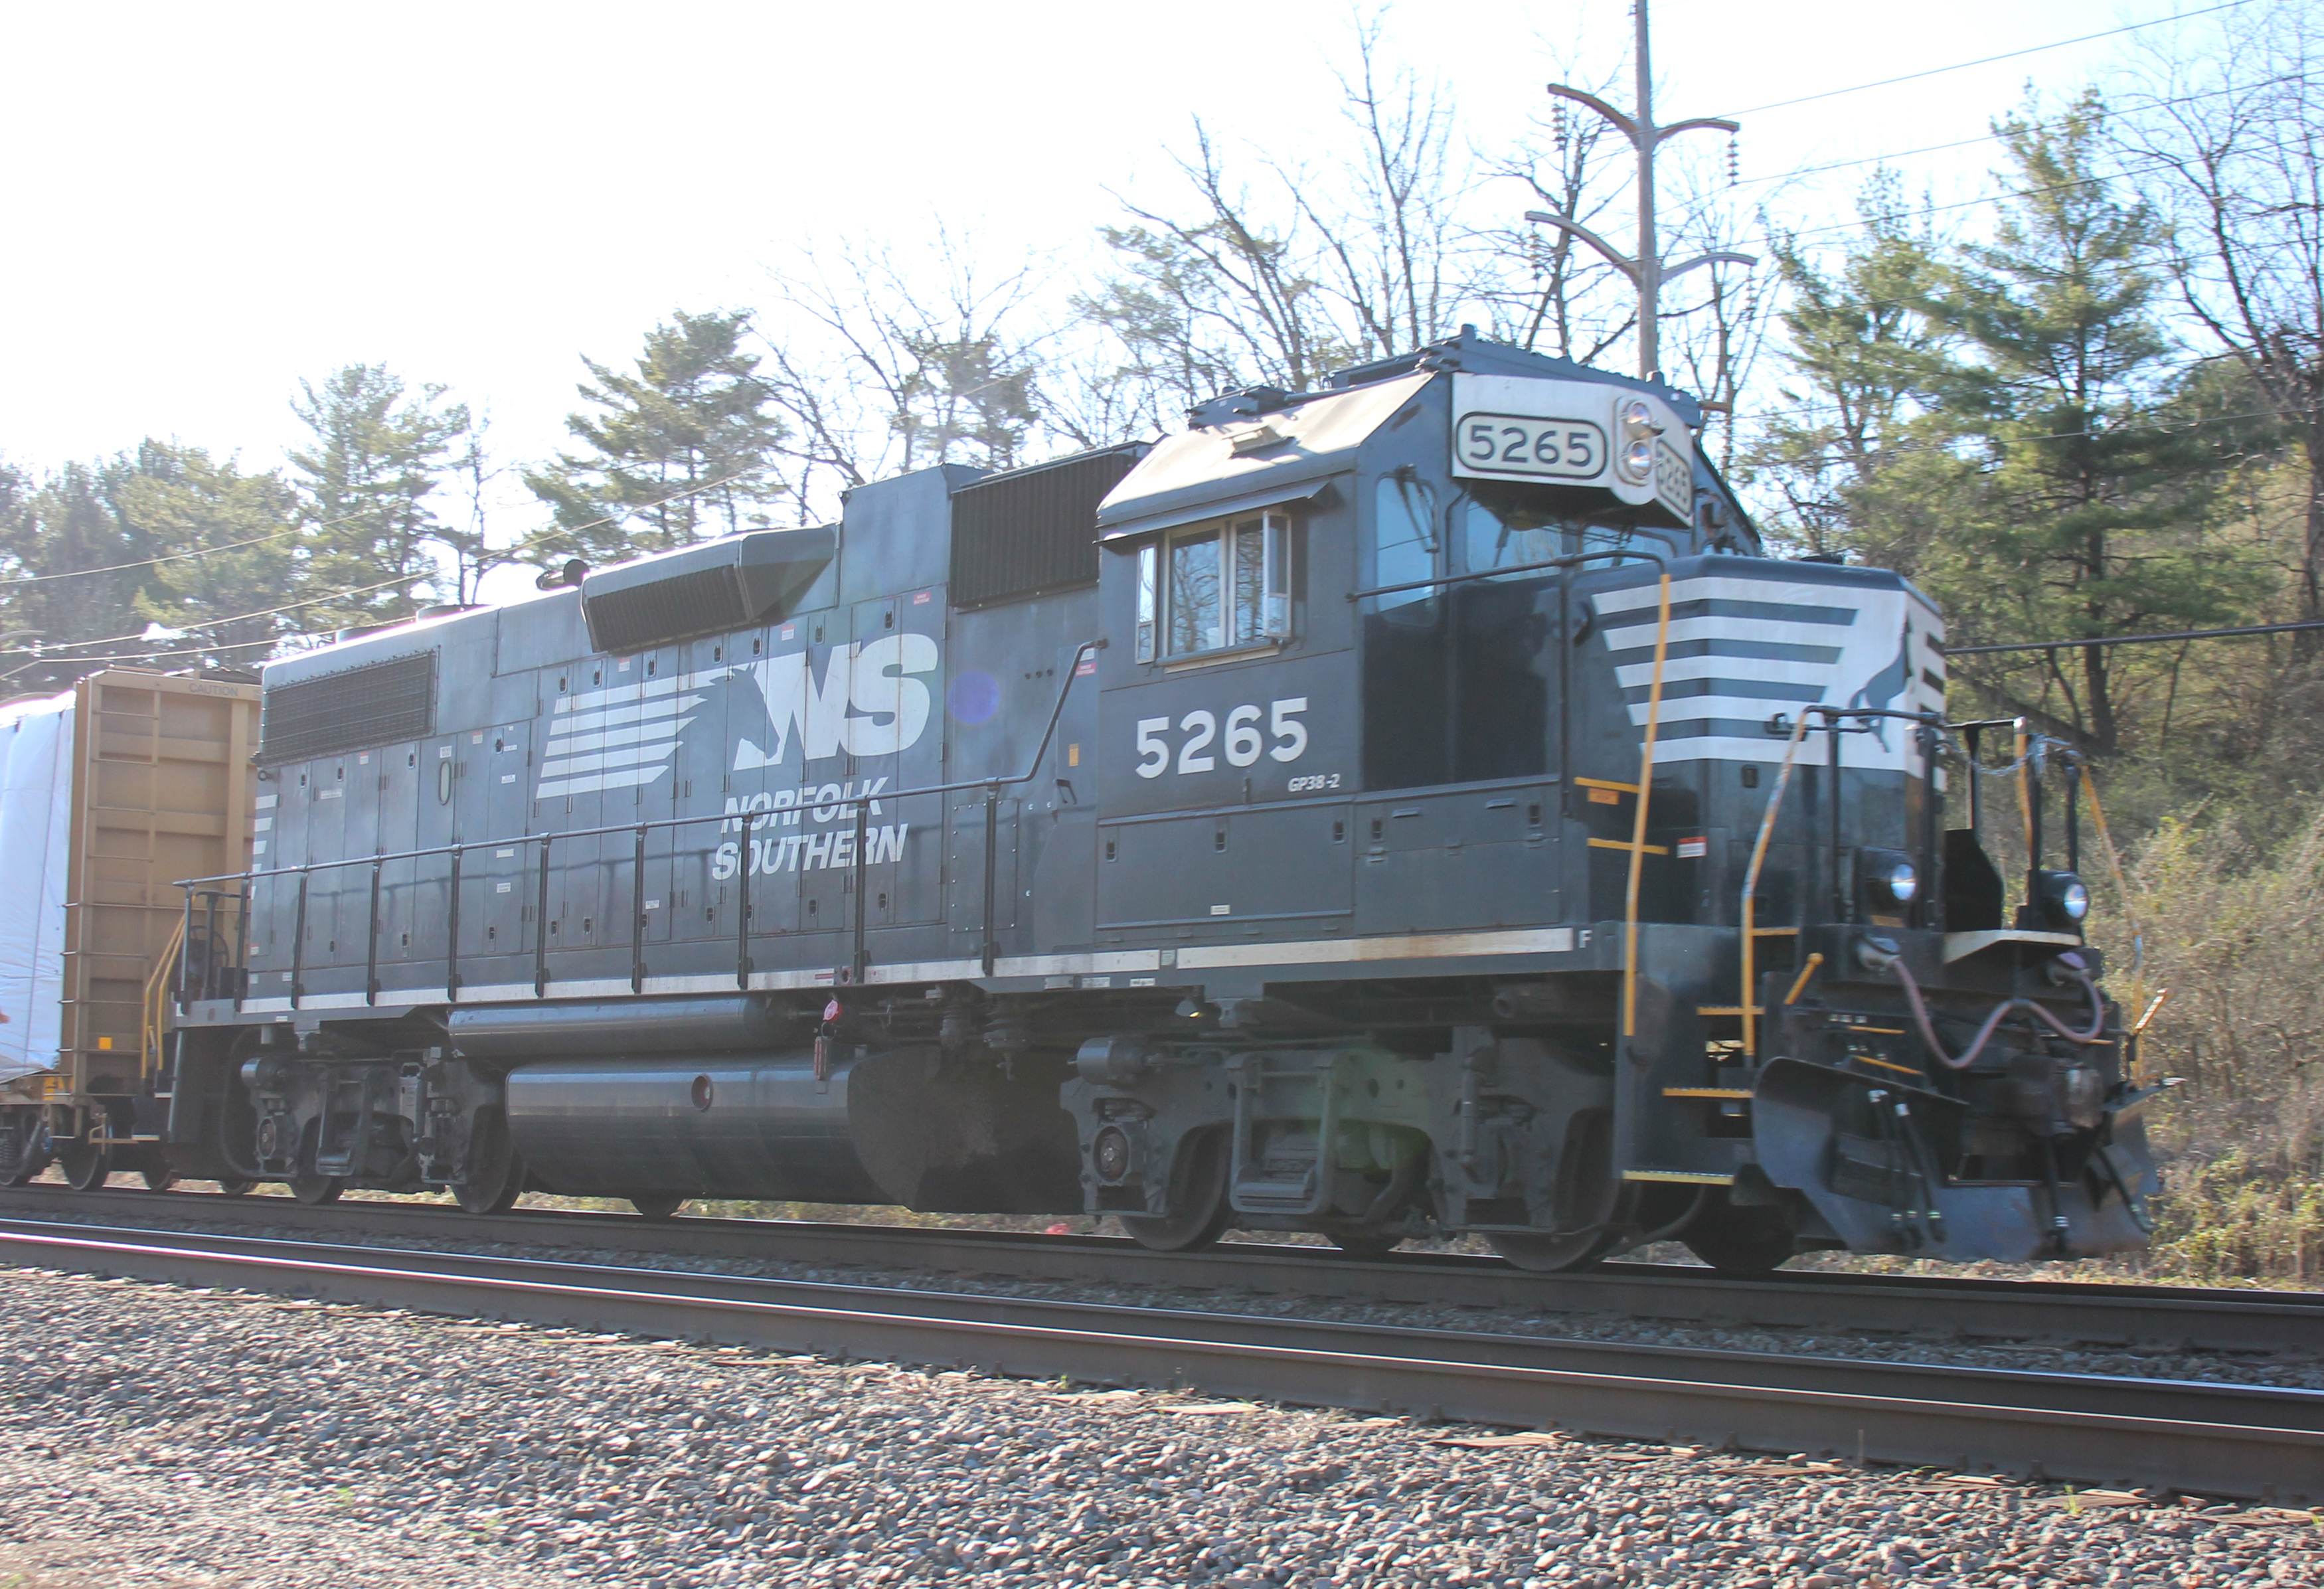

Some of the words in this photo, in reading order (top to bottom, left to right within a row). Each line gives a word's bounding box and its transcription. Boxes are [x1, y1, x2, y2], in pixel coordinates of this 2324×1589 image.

[1469, 425, 1592, 466] 5265
[189, 683, 238, 697] CAUTION
[733, 633, 938, 771] NS
[1135, 697, 1308, 779] 5265
[720, 776, 888, 833] NORFOLK
[1288, 774, 1340, 792] GP38-2
[712, 823, 908, 881] SOUTHERN
[1578, 930, 1592, 948] F
